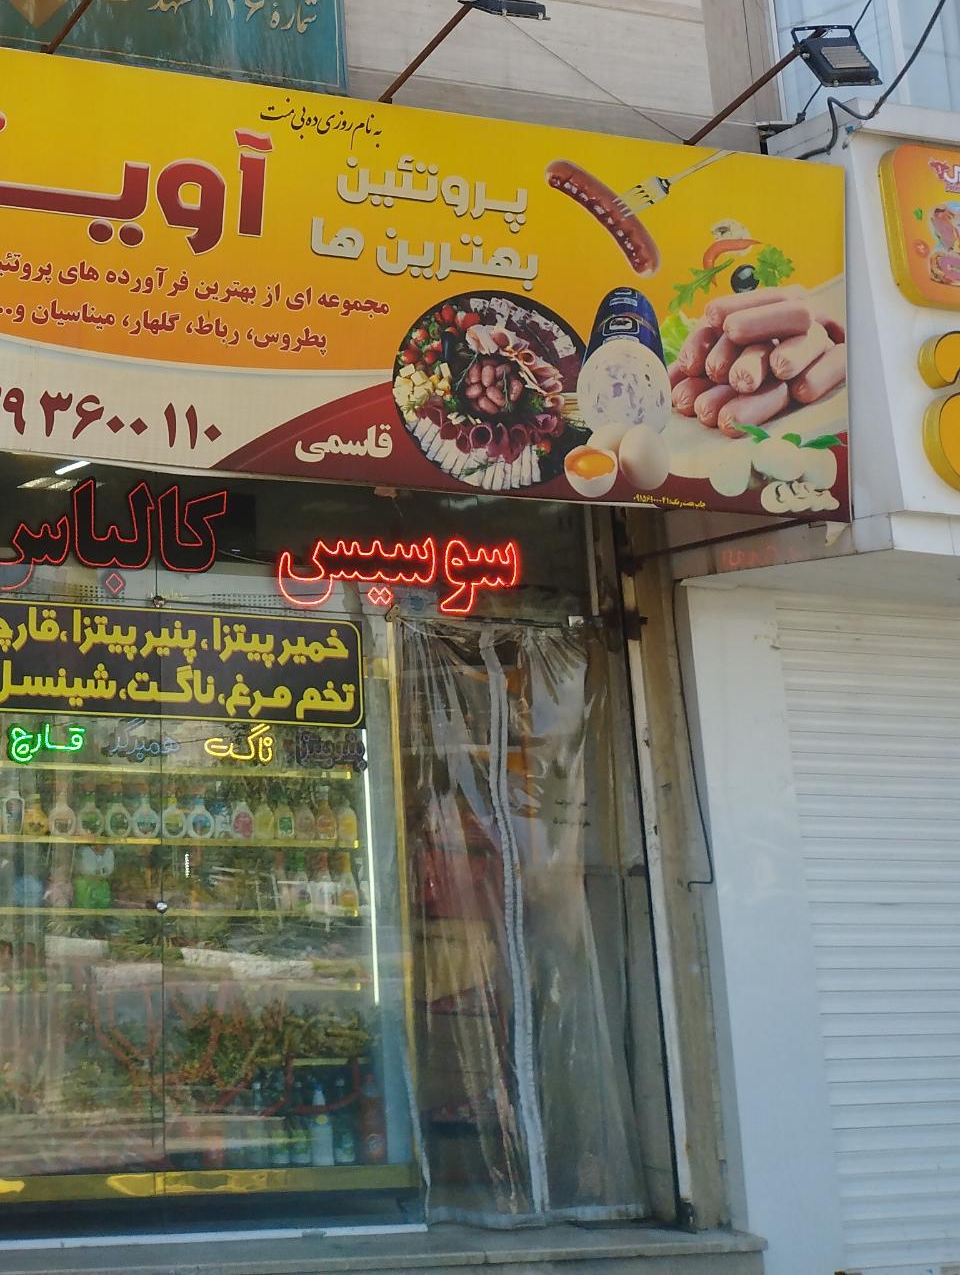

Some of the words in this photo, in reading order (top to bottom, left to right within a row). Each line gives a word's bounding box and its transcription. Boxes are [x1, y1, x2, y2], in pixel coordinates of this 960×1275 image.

[350, 113, 375, 151] نام
[336, 153, 528, 233] پروتئین
[310, 215, 366, 260] ها
[56, 260, 101, 285] های
[375, 227, 539, 292] بهترین
[104, 265, 190, 295] فرآورده
[194, 277, 258, 307] بهترین
[261, 282, 282, 310] از
[30, 298, 117, 328] میناسیان
[285, 286, 314, 313] ای
[315, 292, 392, 320] مجموعه
[293, 422, 394, 464] قاسمی
[276, 533, 520, 616] سوسیس
[138, 619, 196, 661] پنیر
[277, 627, 350, 665] خمیر
[295, 681, 356, 720] تخم
[7, 723, 86, 764] قارچ
[203, 723, 274, 764] ناگت
